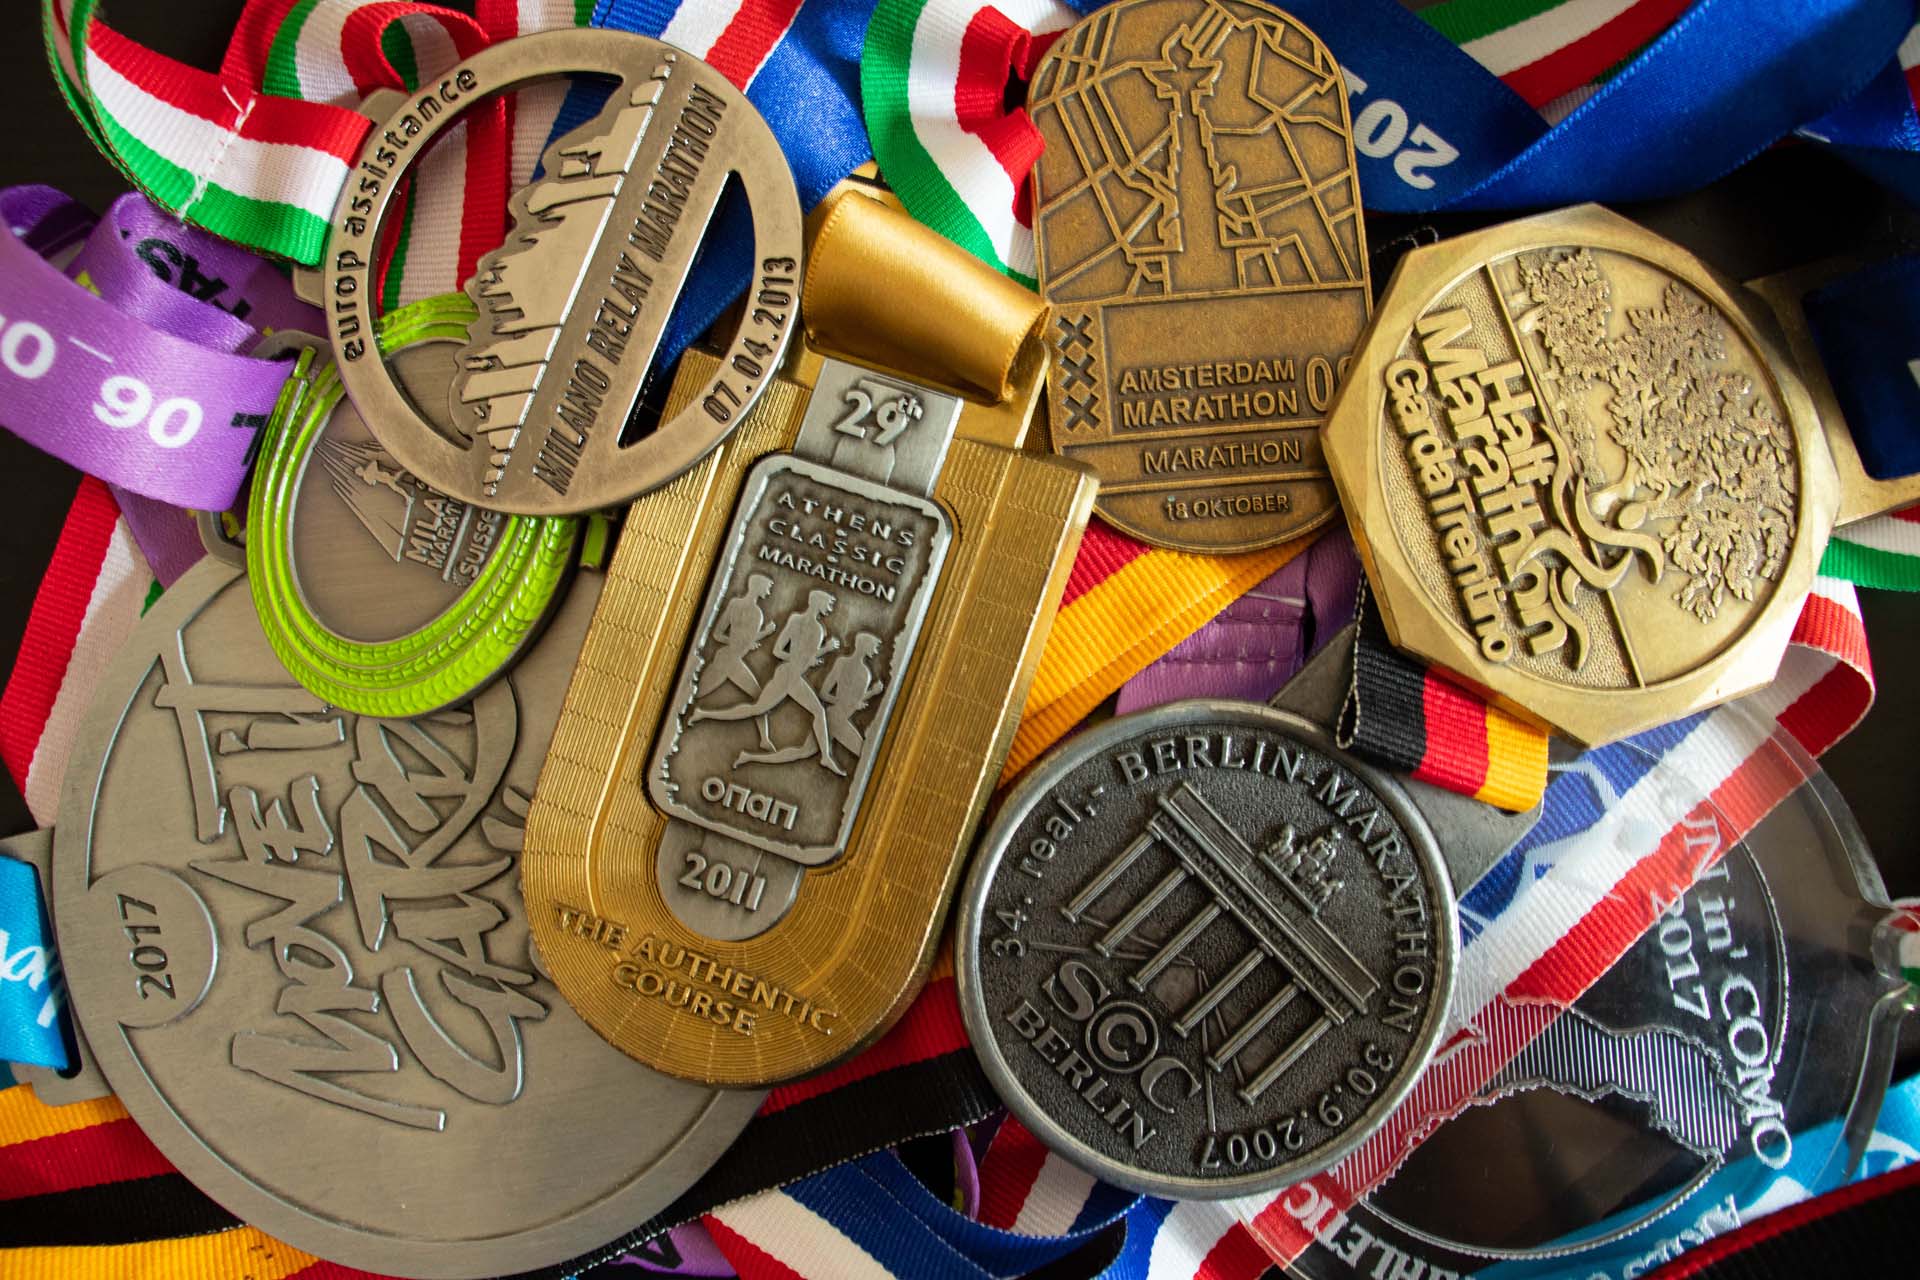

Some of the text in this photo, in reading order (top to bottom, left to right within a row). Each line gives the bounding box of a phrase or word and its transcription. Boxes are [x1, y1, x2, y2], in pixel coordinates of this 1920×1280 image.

[335, 68, 478, 362] europ assistance
[533, 83, 728, 496] MILANO RELAY MARATHON
[703, 257, 796, 424] 07.04.2013
[1120, 359, 1295, 395] AMSTERDAM
[93, 376, 203, 448] 90
[835, 379, 923, 446] 29th
[1122, 388, 1300, 428] MARATHON
[1144, 439, 1300, 474] MARATHON
[1416, 308, 1568, 657] Marathon
[406, 487, 449, 564] MILA
[427, 500, 463, 569] MARAT
[777, 490, 915, 547] ATHENS
[1193, 494, 1289, 518] OKTOBER
[759, 545, 896, 602] MARATHON
[769, 519, 906, 576] CLASSIC
[679, 852, 768, 912] 2011
[116, 892, 175, 1000] 2017
[554, 904, 840, 1036] THE AUTHENTIC
[1651, 883, 1711, 1021] 2017
[613, 961, 758, 1037] COURSE
[997, 1001, 1157, 1150] BERLIN
[1719, 972, 1792, 1170] COMO
